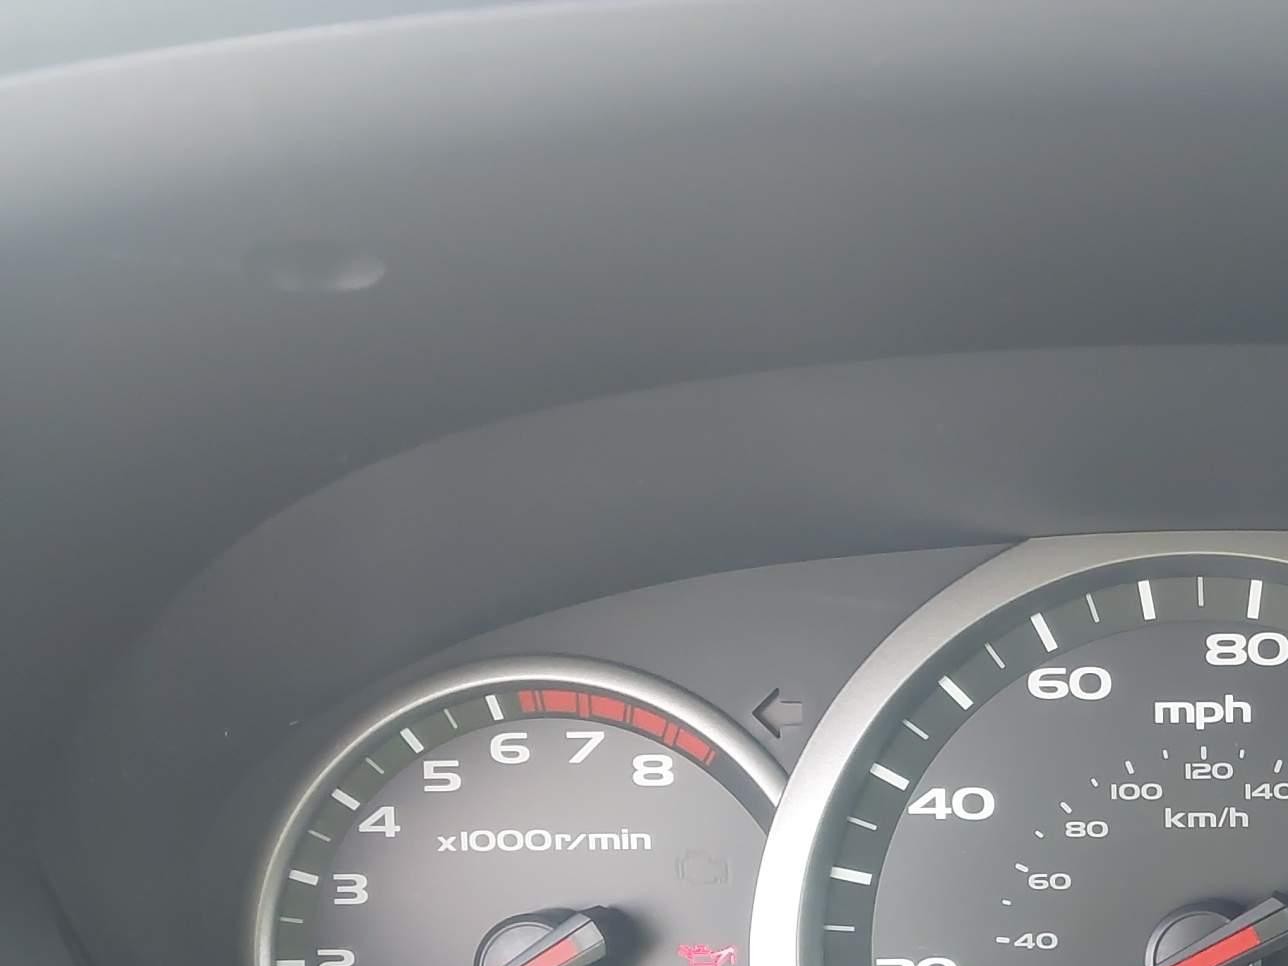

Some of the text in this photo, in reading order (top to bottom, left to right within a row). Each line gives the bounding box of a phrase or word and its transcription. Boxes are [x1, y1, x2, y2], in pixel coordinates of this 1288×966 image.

[1027, 667, 1112, 700] 60
[1154, 694, 1252, 729] mph
[490, 732, 530, 765] 6
[566, 732, 605, 763] 7
[423, 760, 461, 792] 5
[632, 754, 674, 786] 8
[1184, 762, 1234, 780] 120
[908, 787, 995, 820] 40
[1110, 782, 1163, 800] 100
[358, 806, 401, 837] 4
[1065, 821, 1109, 838] 80
[1164, 807, 1249, 829] km/h
[333, 874, 368, 904] 3
[1028, 873, 1072, 890] 60
[1014, 933, 1058, 949] 40
